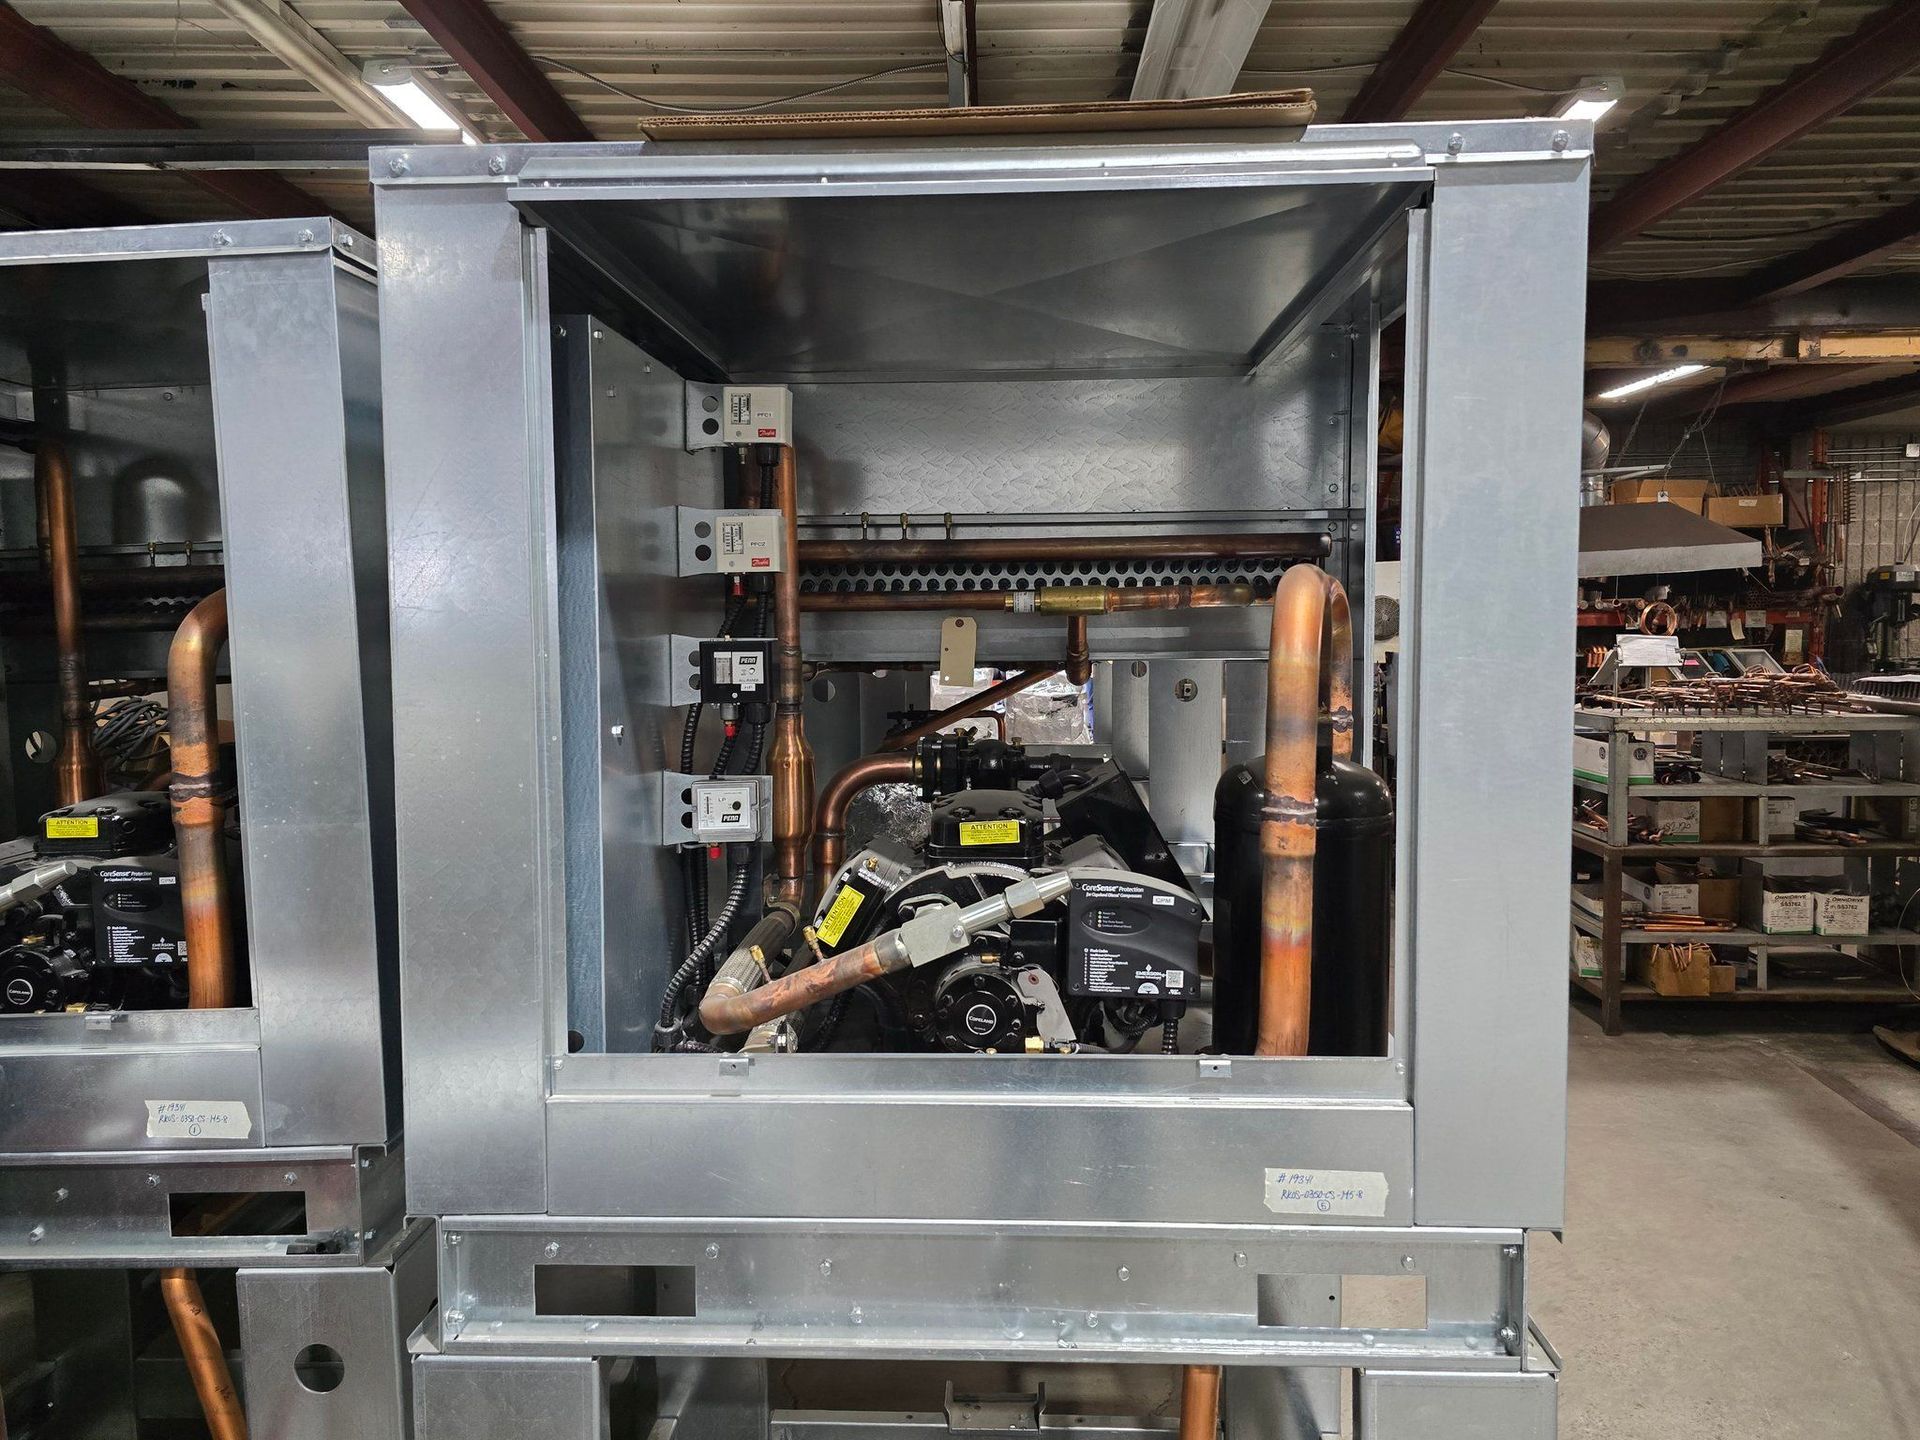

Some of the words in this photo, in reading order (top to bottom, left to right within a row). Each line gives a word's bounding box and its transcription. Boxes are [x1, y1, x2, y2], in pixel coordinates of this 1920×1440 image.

[1118, 885, 1144, 893] Protection
[823, 895, 847, 930] ATTENTION
[968, 1015, 994, 1025] COPELAND
[1288, 1173, 1314, 1184] 19341
